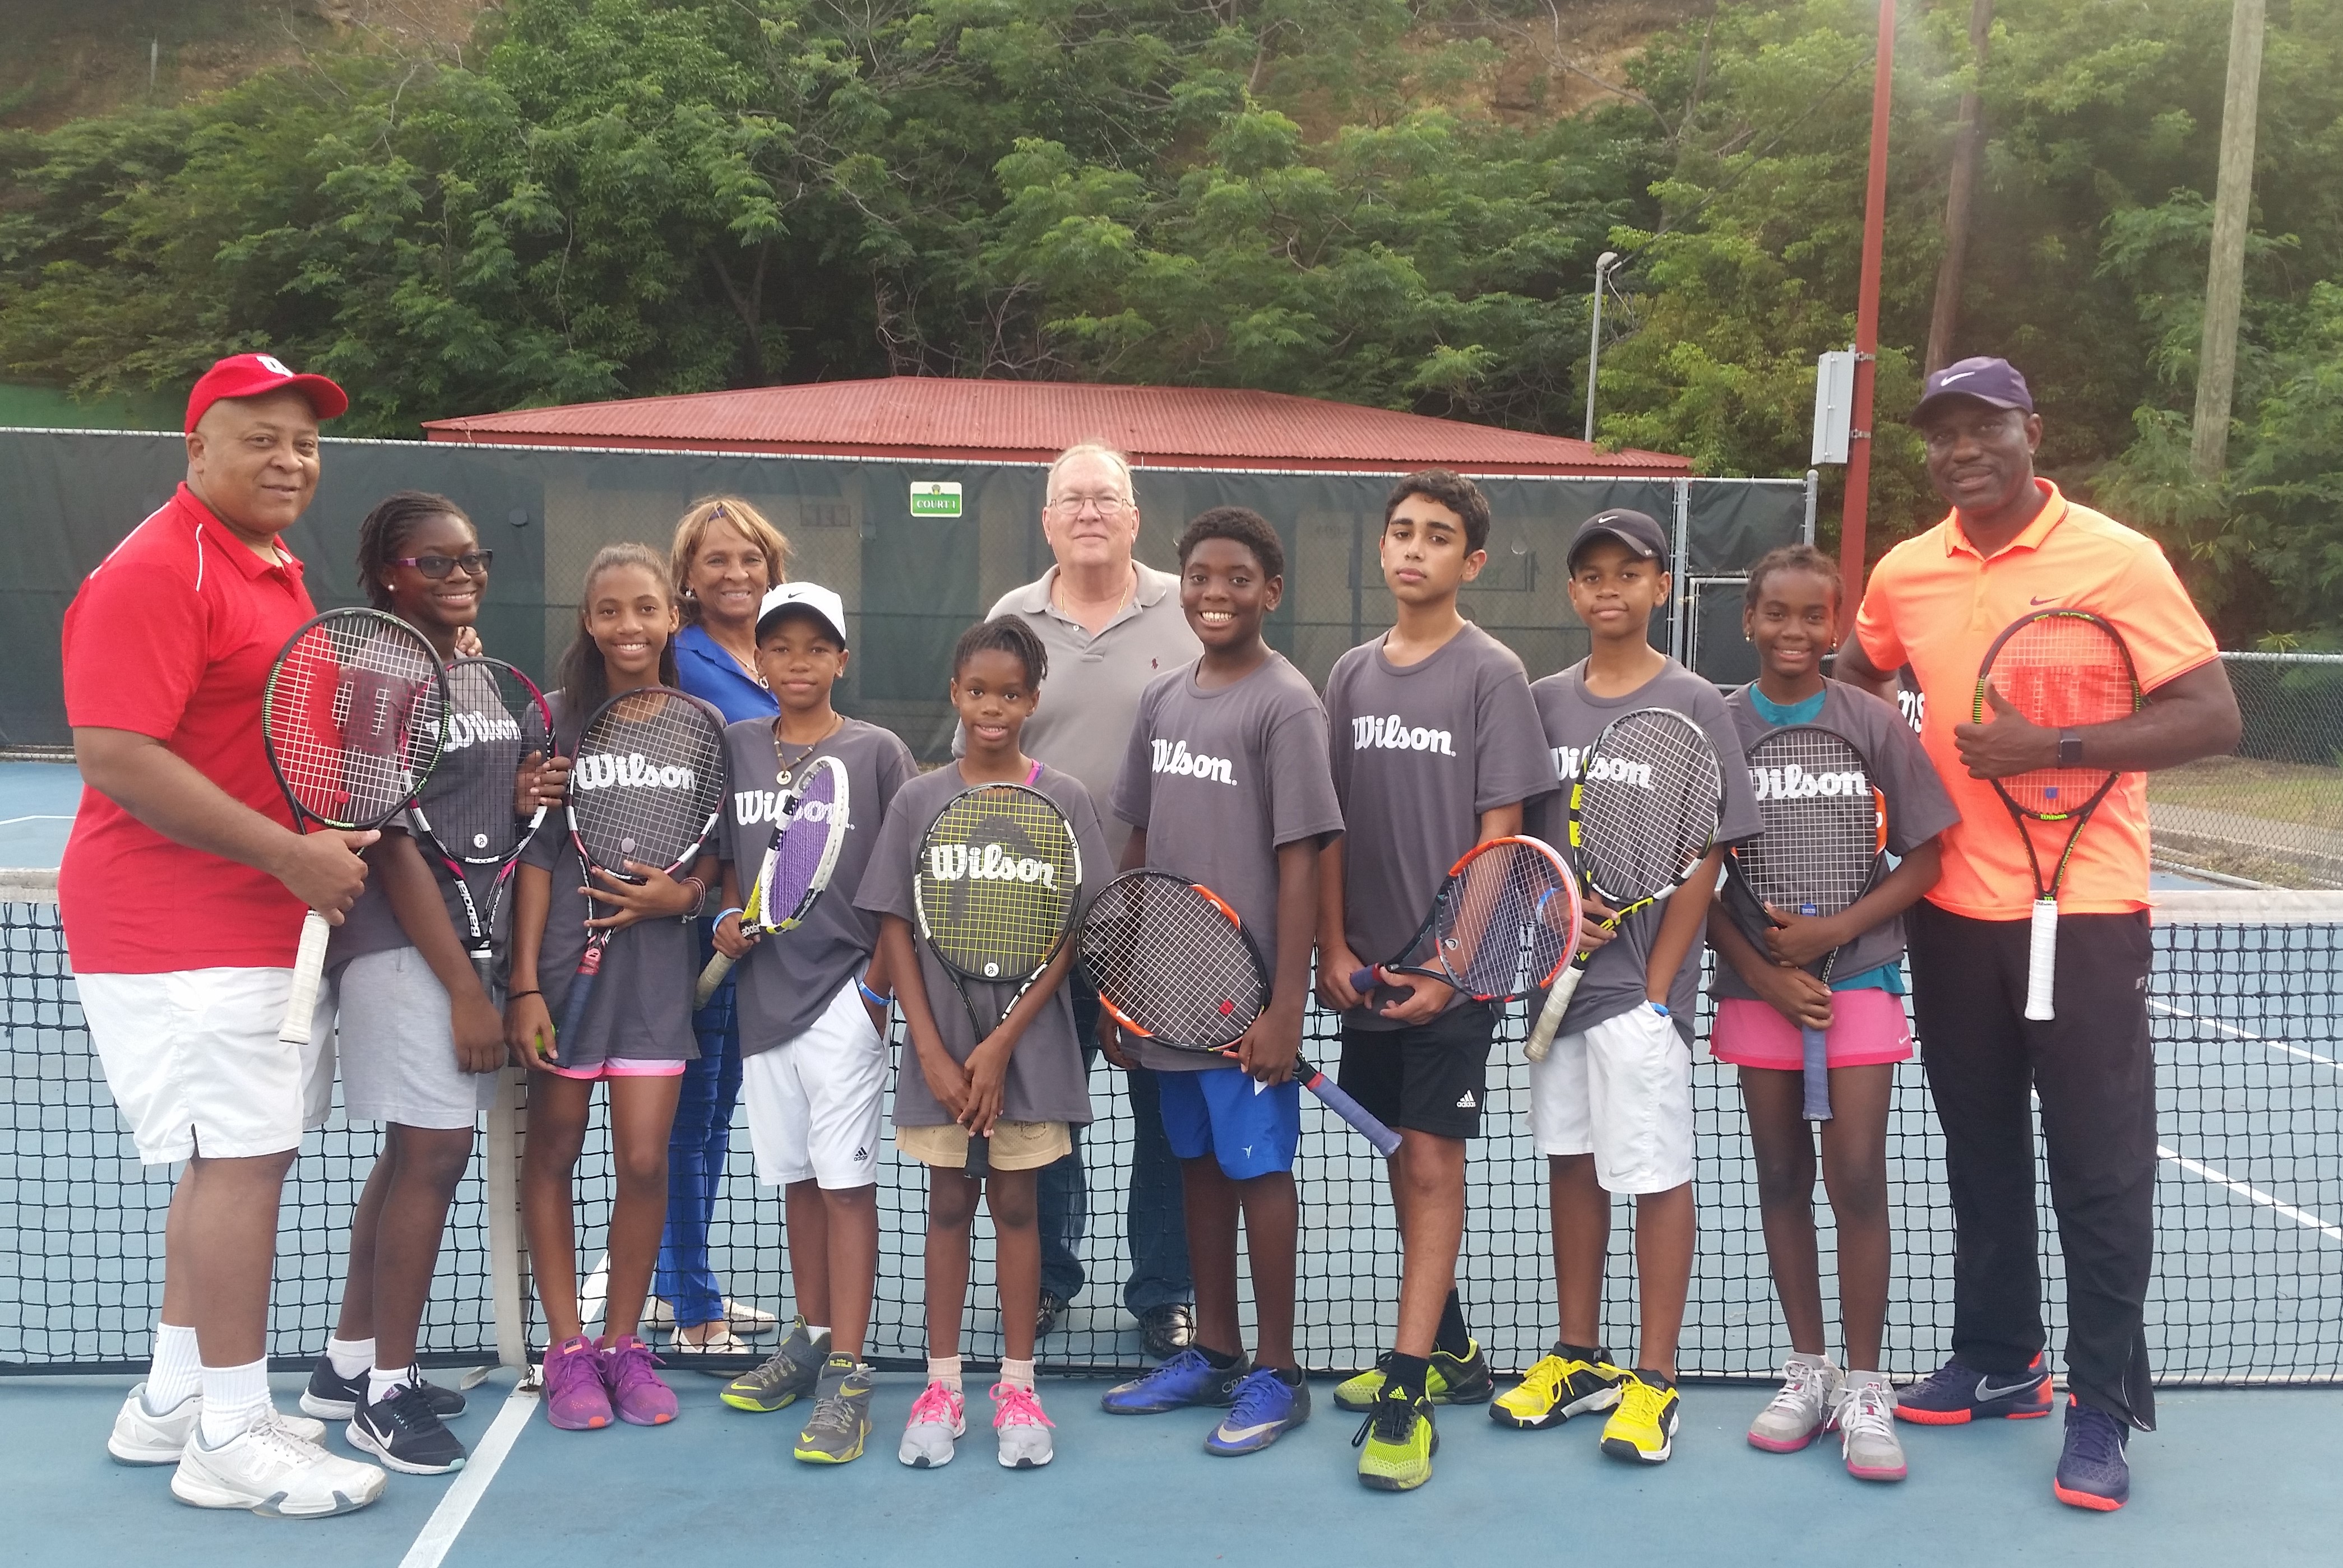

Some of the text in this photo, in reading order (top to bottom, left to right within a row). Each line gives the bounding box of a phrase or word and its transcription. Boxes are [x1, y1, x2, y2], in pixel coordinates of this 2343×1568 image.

[916, 500, 956, 509] COURT 1
[1352, 714, 1452, 756] Wilson
[1151, 739, 1232, 785] Wilson
[930, 844, 1054, 888] Wilson
[453, 876, 481, 938] Babolat
